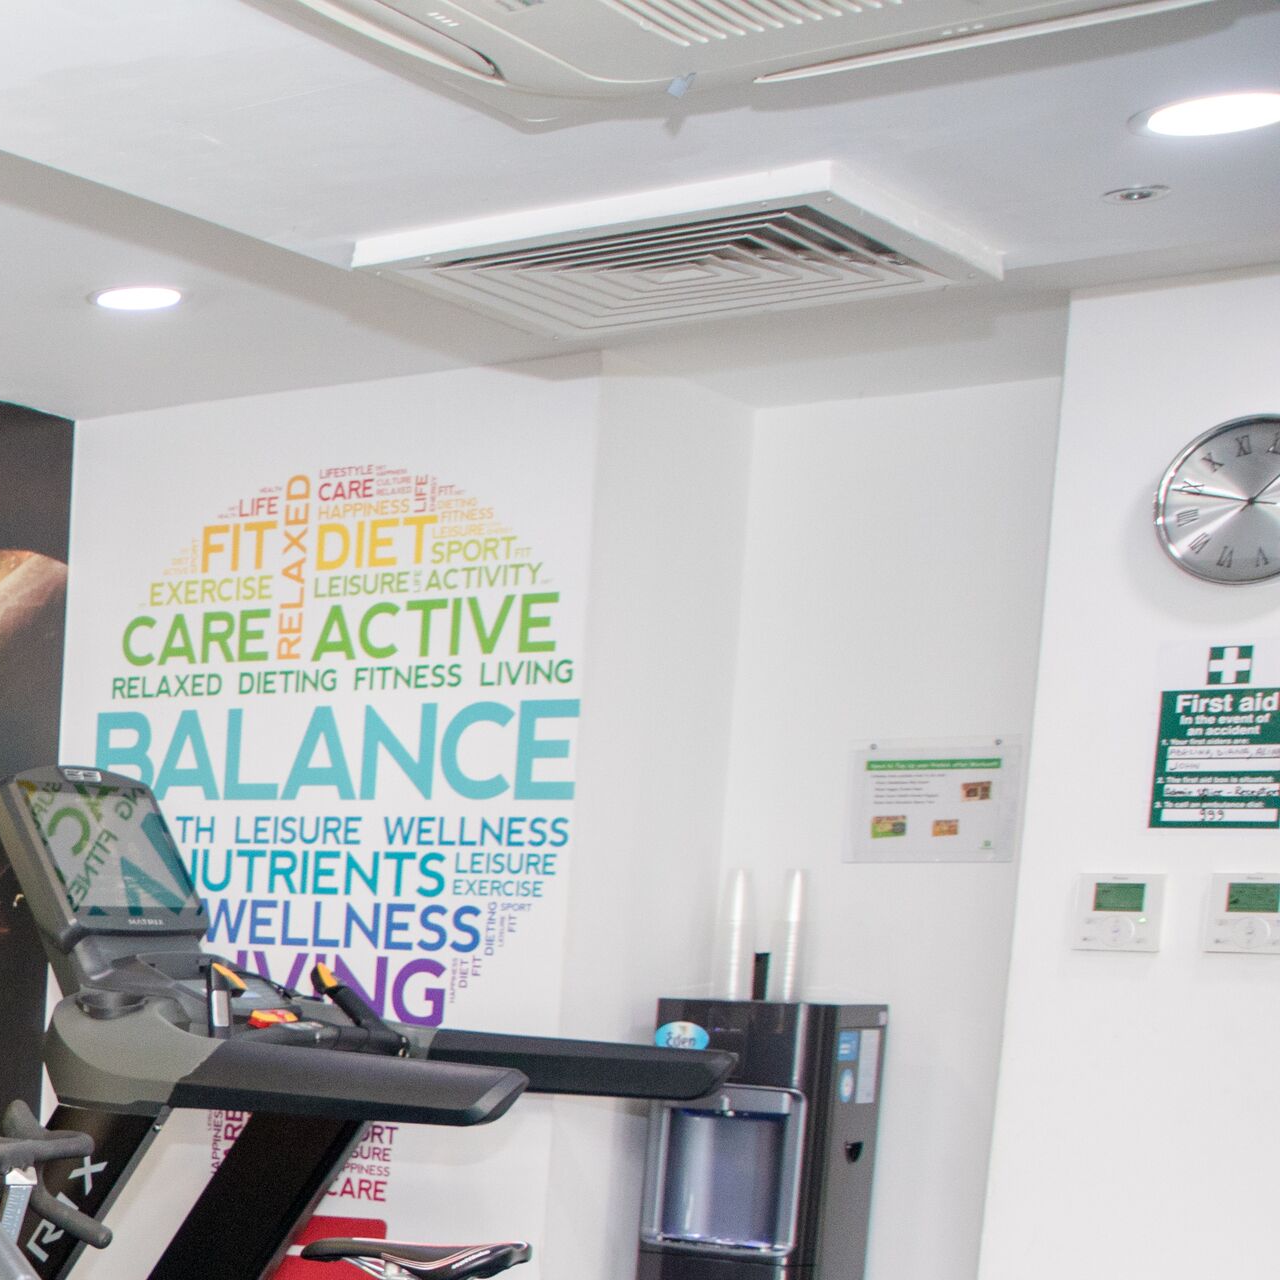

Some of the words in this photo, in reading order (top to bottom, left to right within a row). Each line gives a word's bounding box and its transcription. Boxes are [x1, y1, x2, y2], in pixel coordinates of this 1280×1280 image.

[319, 464, 374, 480] LIFESTYLE
[318, 479, 375, 502] CARE
[376, 486, 413, 497] RELAXED
[414, 474, 429, 513] LIFE
[438, 485, 455, 497] FIT
[239, 496, 280, 518] LIFE
[318, 498, 411, 521] HAPPINESS
[440, 508, 494, 522] FITNESS
[432, 523, 486, 539] LEISURE
[201, 520, 278, 574] FIT
[316, 515, 439, 571] DIET
[431, 536, 517, 565] SPORT
[277, 474, 311, 660] RELAXED
[425, 562, 543, 592] ACTIVITY
[149, 575, 273, 607] EXERCISE
[314, 571, 410, 599] LEISURE
[121, 608, 271, 667] CARE
[311, 591, 561, 663] ACTIVE
[112, 673, 222, 700] RELAXED
[239, 669, 338, 696] DIETING
[353, 664, 463, 692] FITNESS
[479, 659, 574, 688] LIVING
[1175, 694, 1234, 714] First
[1238, 691, 1280, 712] aid
[1194, 713, 1217, 725] the
[1218, 713, 1255, 724] event
[1255, 712, 1272, 723] of
[1186, 726, 1204, 737] an
[1204, 725, 1261, 736] accident
[94, 698, 581, 802] BALANCE
[234, 816, 362, 846] LEISURE
[383, 816, 569, 848] WELLNESS
[454, 852, 557, 876] LEISURE
[452, 879, 543, 898] EXERCISE
[500, 902, 532, 913] SPORT
[127, 917, 165, 927] MATRIX
[200, 897, 482, 954] WELLNESS
[484, 901, 498, 957] DIETING
[507, 914, 518, 934] FIT
[458, 958, 470, 989] DIET
[471, 955, 483, 977] FIT
